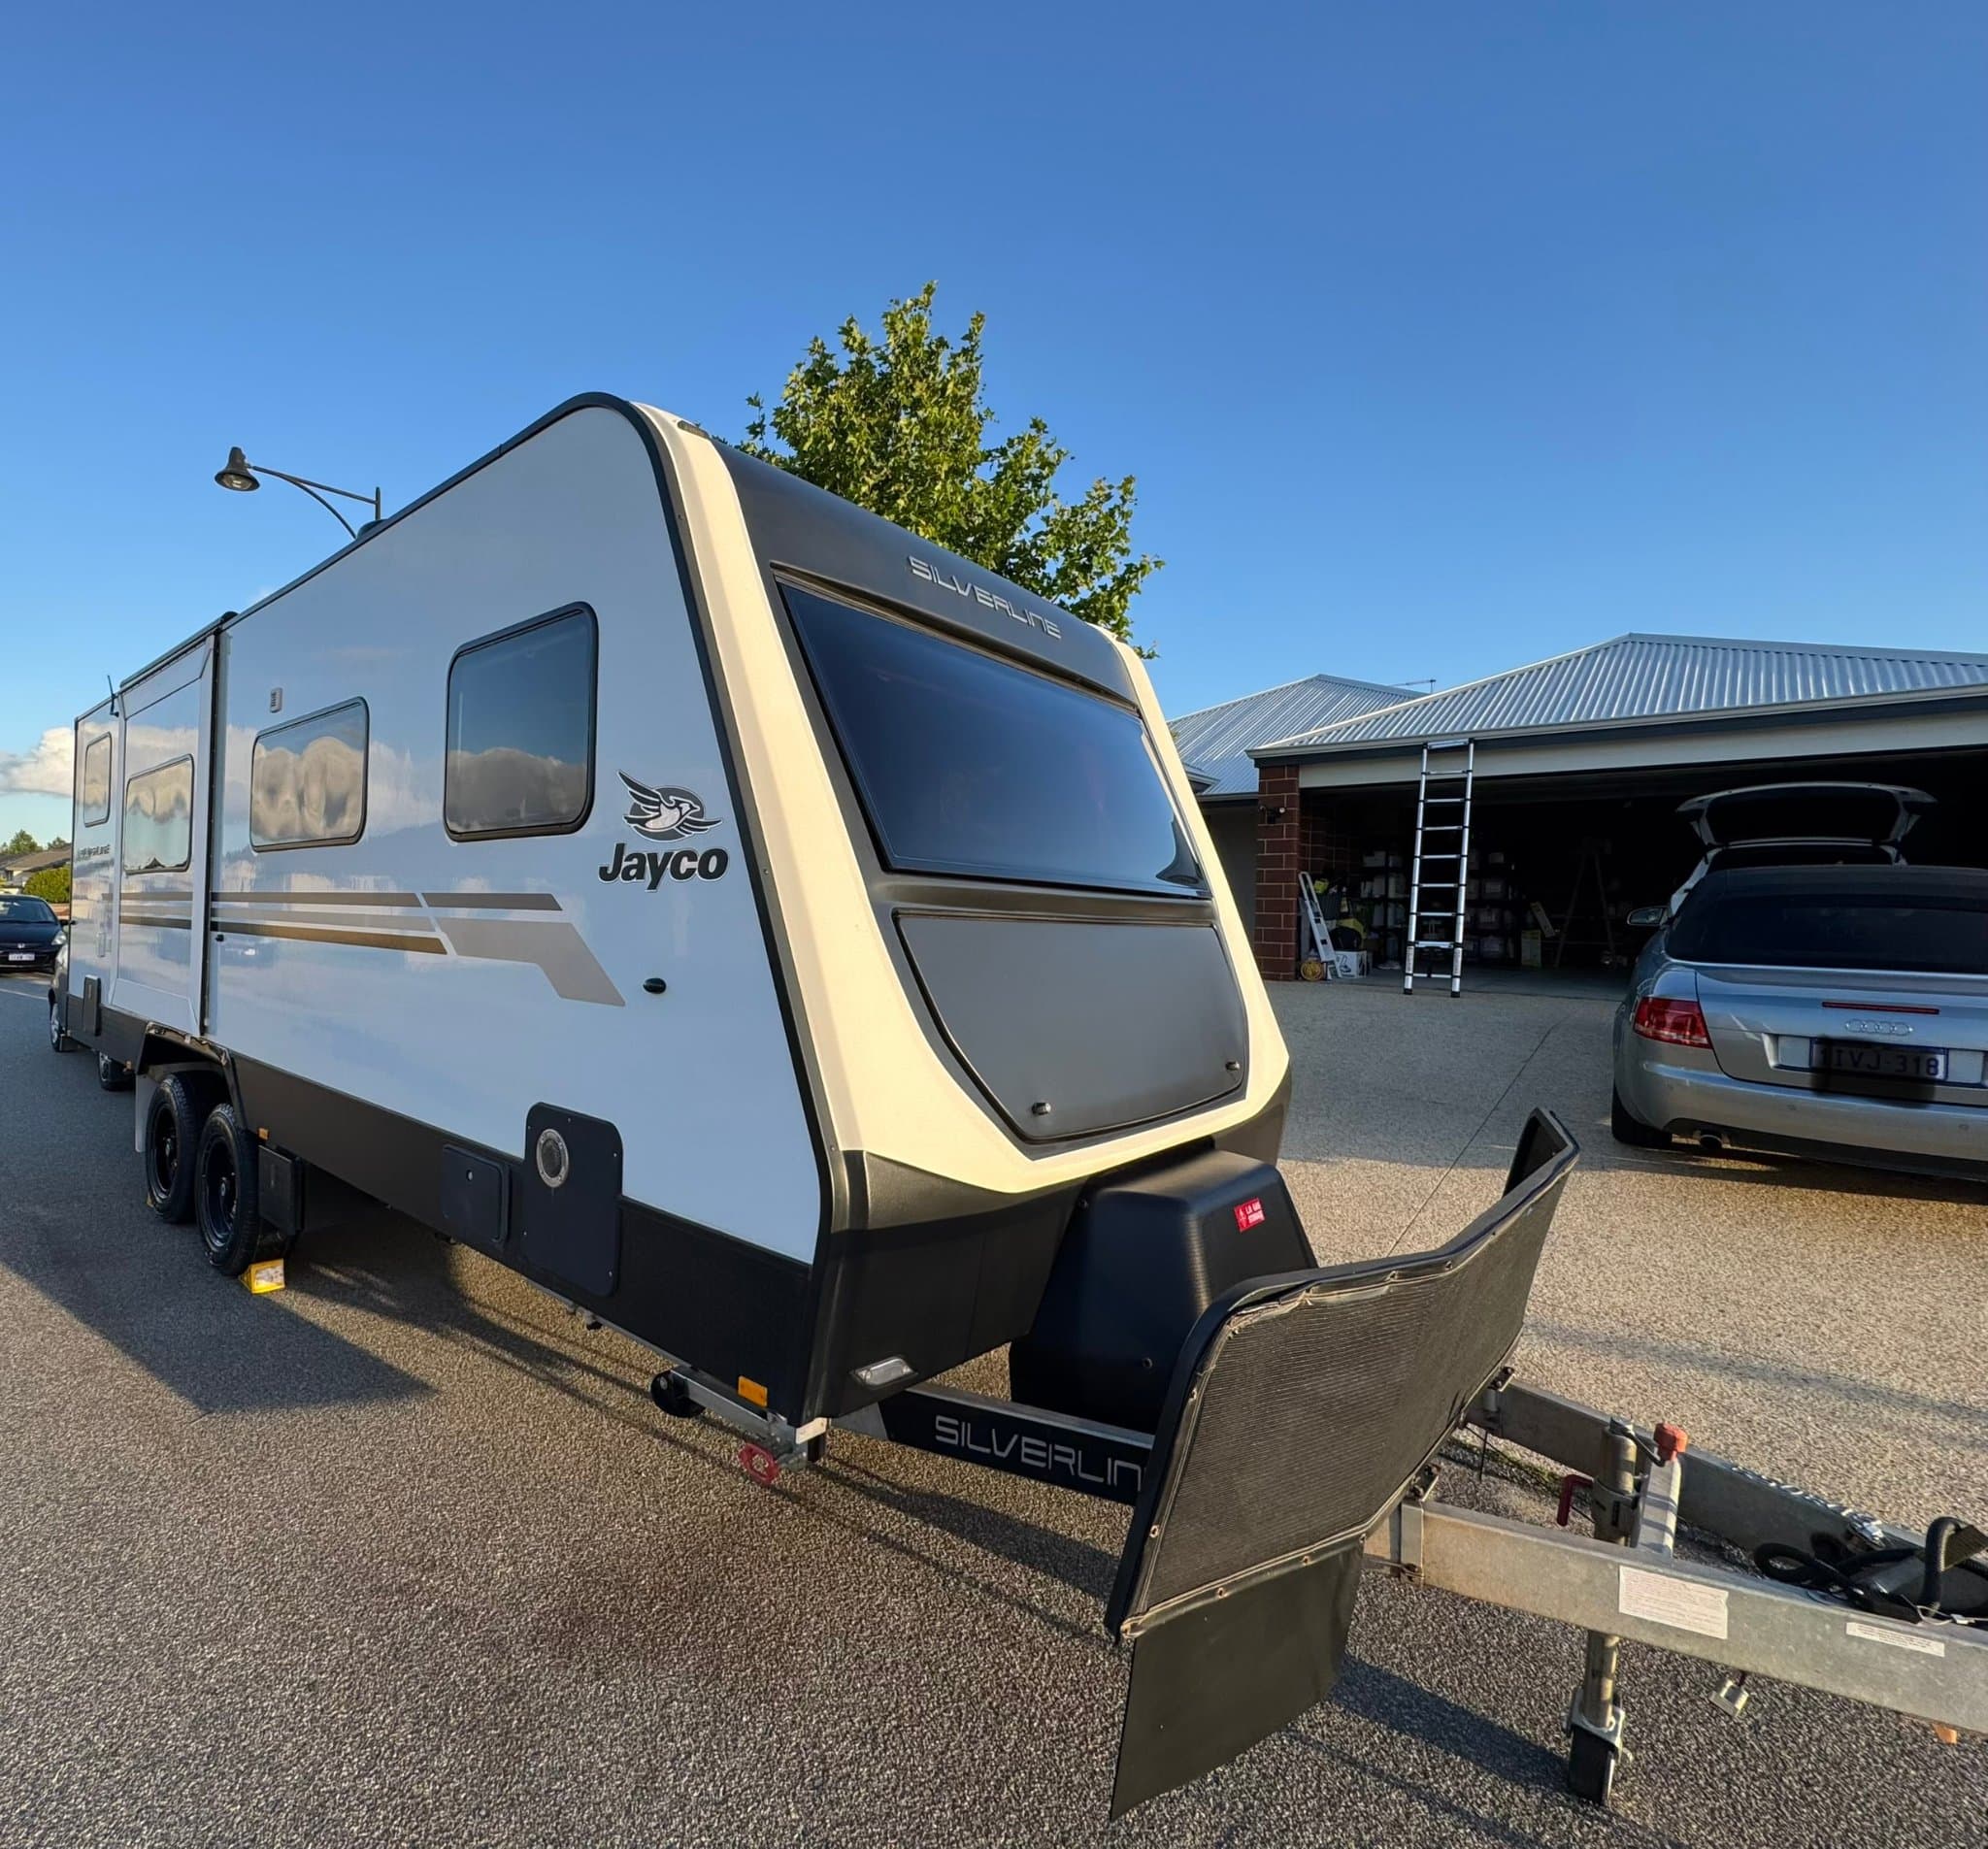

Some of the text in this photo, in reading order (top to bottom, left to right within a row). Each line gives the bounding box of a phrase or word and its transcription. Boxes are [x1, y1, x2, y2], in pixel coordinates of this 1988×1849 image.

[908, 555, 1062, 640] SILVERLINE
[598, 842, 730, 892] Jayco
[935, 1415, 1146, 1493] SILVERLIN
